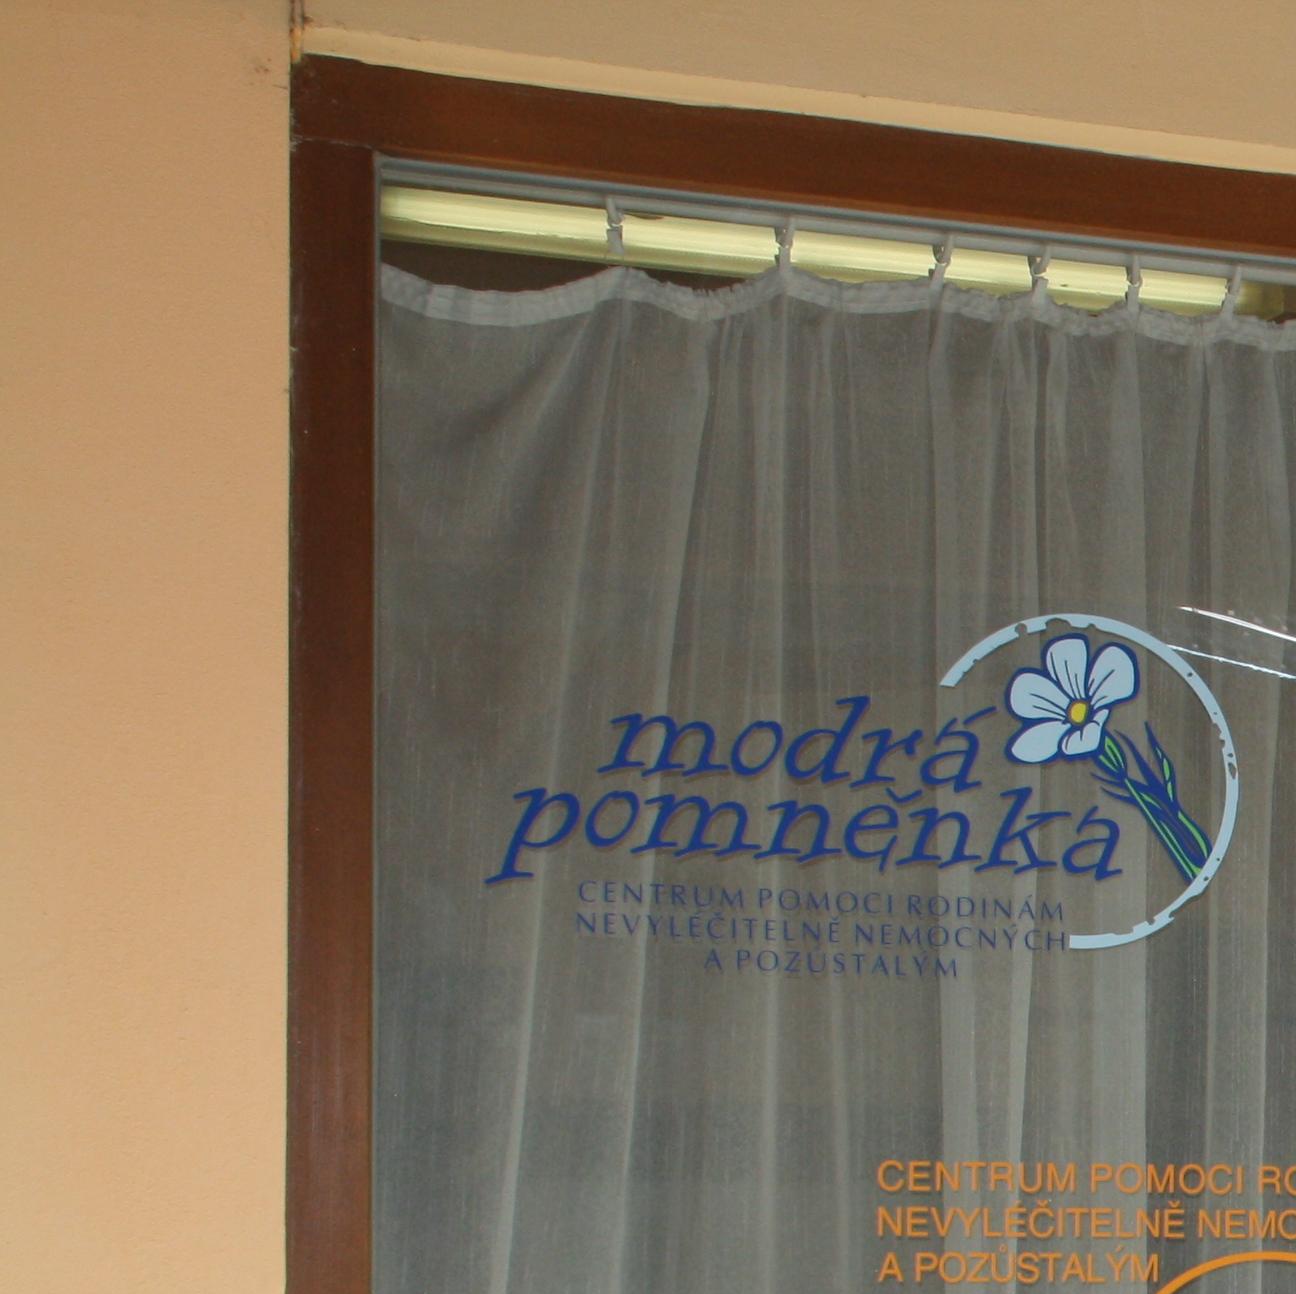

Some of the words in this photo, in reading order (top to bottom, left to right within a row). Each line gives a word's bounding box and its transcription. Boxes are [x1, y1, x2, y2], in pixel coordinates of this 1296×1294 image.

[596, 695, 997, 794] modrá
[484, 786, 1123, 885] pomněnka
[578, 880, 744, 909] CENTRUM
[759, 887, 893, 915] POMOCI
[907, 894, 1064, 921] RODINÁM
[575, 910, 841, 943] NEVYLÉČITELNĚ
[854, 923, 1066, 951] NEMOCNÝCH
[703, 949, 723, 971] A
[876, 1159, 1077, 1194] CENTRUM
[1089, 1162, 1244, 1195] POMOCI
[876, 1200, 1186, 1240] NEVYLÉČITELNĚ
[877, 1252, 904, 1283] A
[914, 1245, 1160, 1284] POZŮSTALÝM
